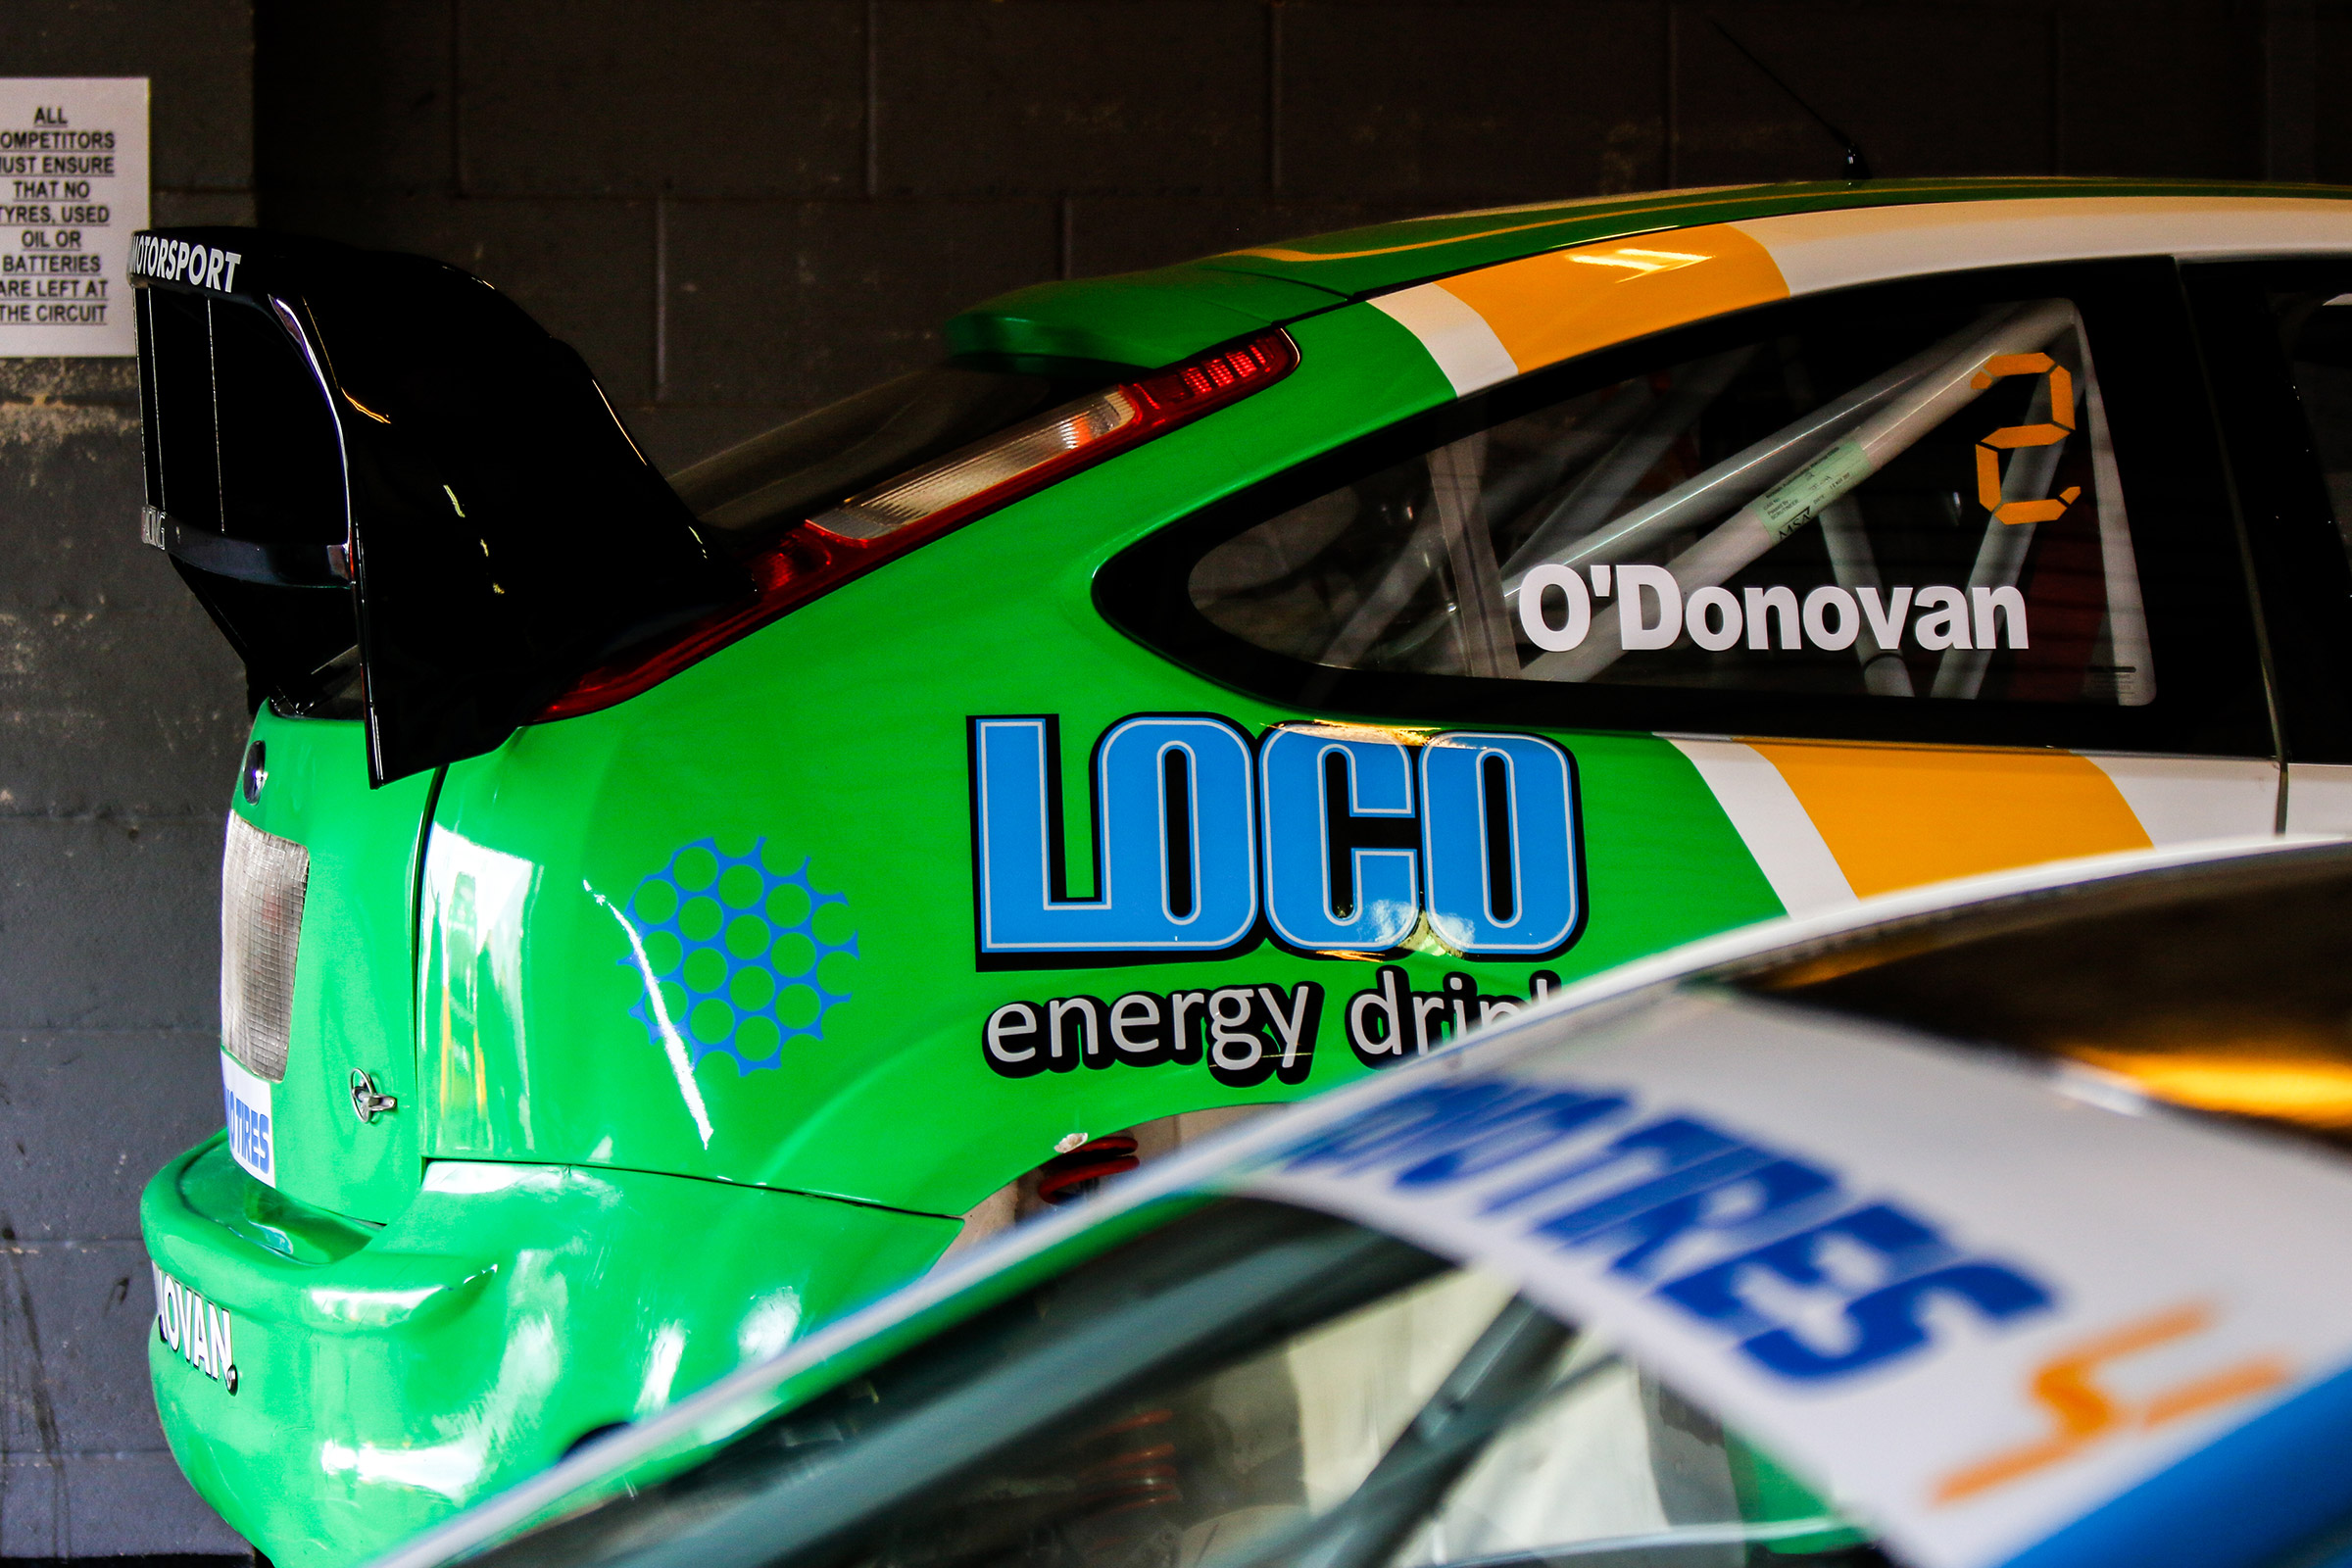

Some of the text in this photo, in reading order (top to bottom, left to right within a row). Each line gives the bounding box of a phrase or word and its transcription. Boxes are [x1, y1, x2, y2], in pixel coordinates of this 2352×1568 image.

[34, 107, 68, 125] ALL
[0, 130, 115, 149] OMPETITORS
[0, 156, 115, 174] UST ENSURE
[13, 180, 90, 198] THAT NO
[61, 205, 110, 223] USED
[22, 229, 82, 248] OIL OR
[3, 255, 102, 272] BATTERIES
[36, 279, 79, 297] LEFT
[85, 279, 109, 297] AT
[0, 304, 108, 322] THE CIRCUIT
[1970, 351, 2082, 525] 2
[1518, 564, 2030, 653] O'Donovan
[968, 712, 1588, 969] LOCO
[986, 969, 1550, 1071] energy drin
[235, 1097, 270, 1175] TIRES
[1473, 1109, 2066, 1386] TIRES
